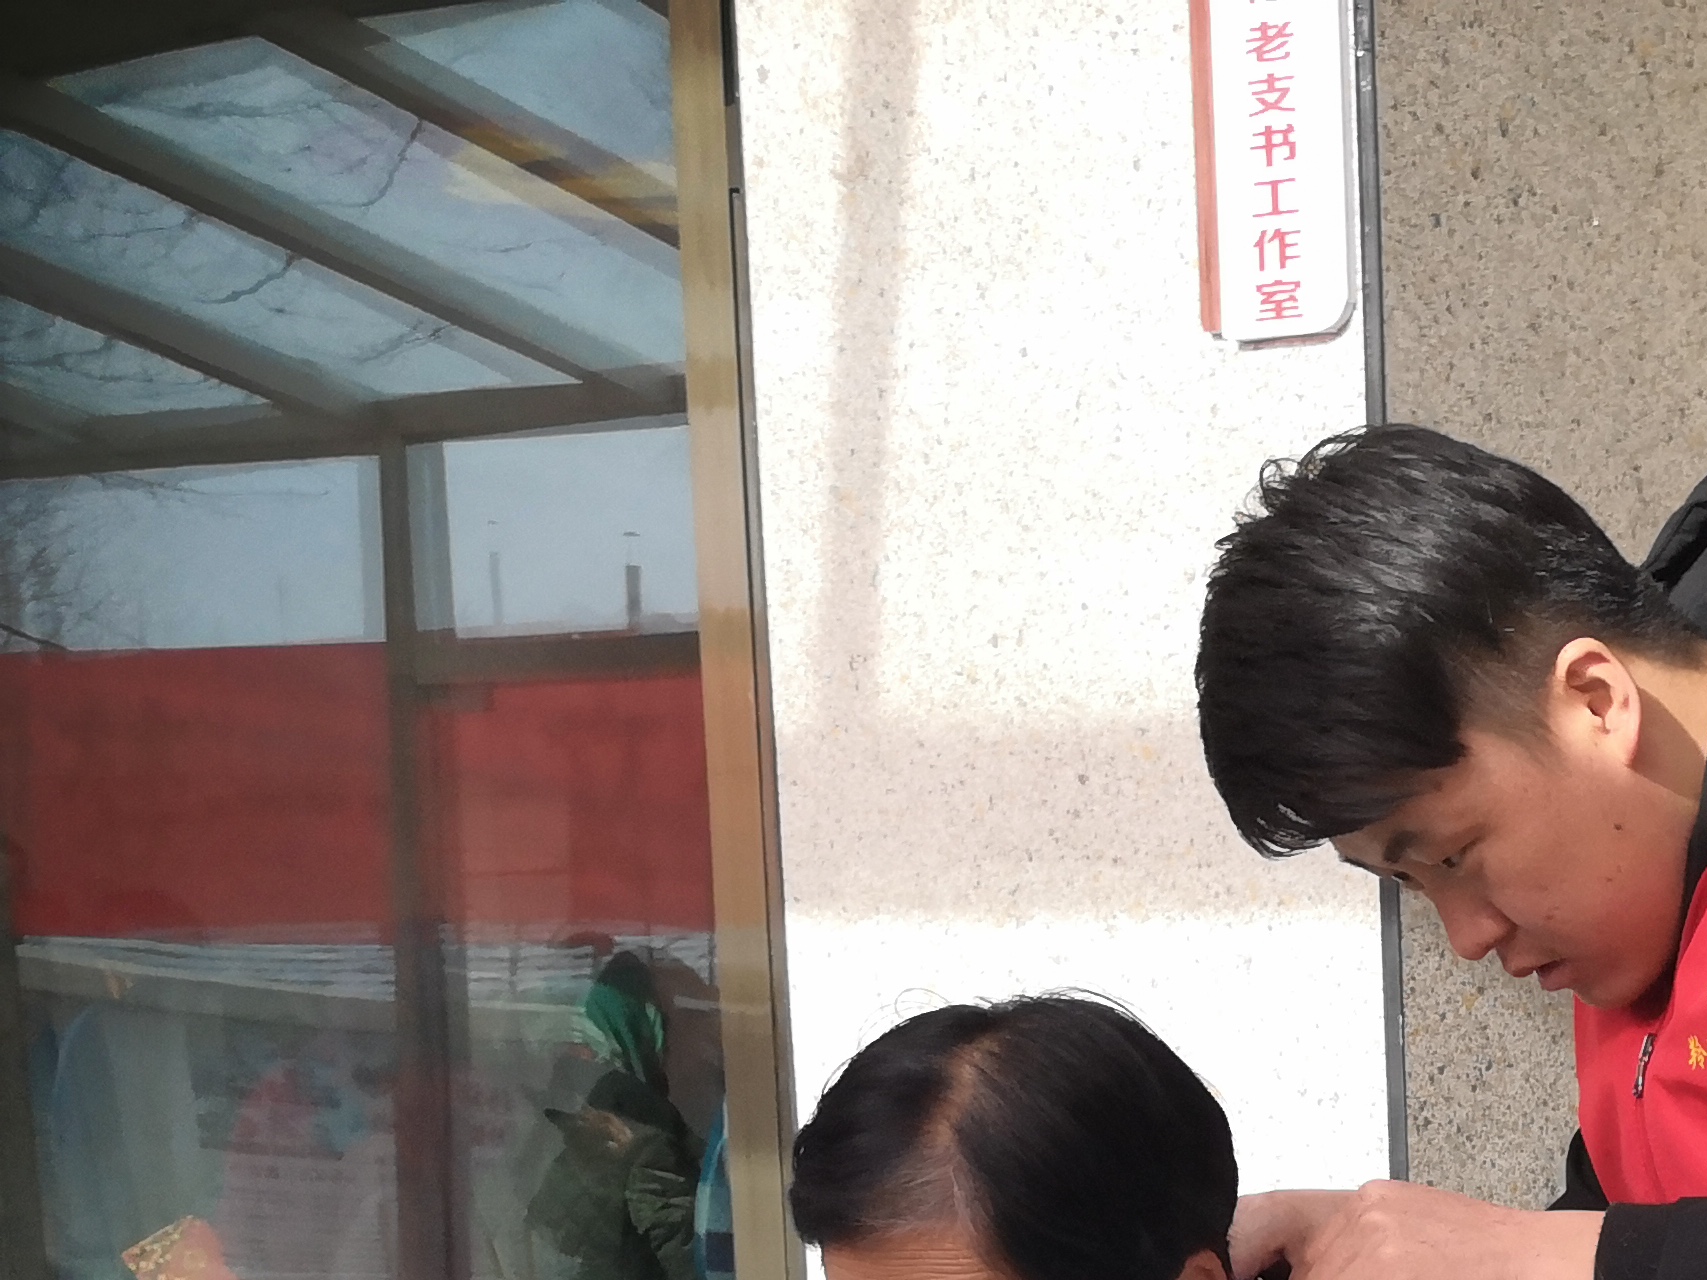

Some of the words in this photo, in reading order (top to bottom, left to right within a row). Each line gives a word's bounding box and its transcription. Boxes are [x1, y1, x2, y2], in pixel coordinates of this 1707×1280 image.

[1246, 21, 1303, 322] 老支书工作室
